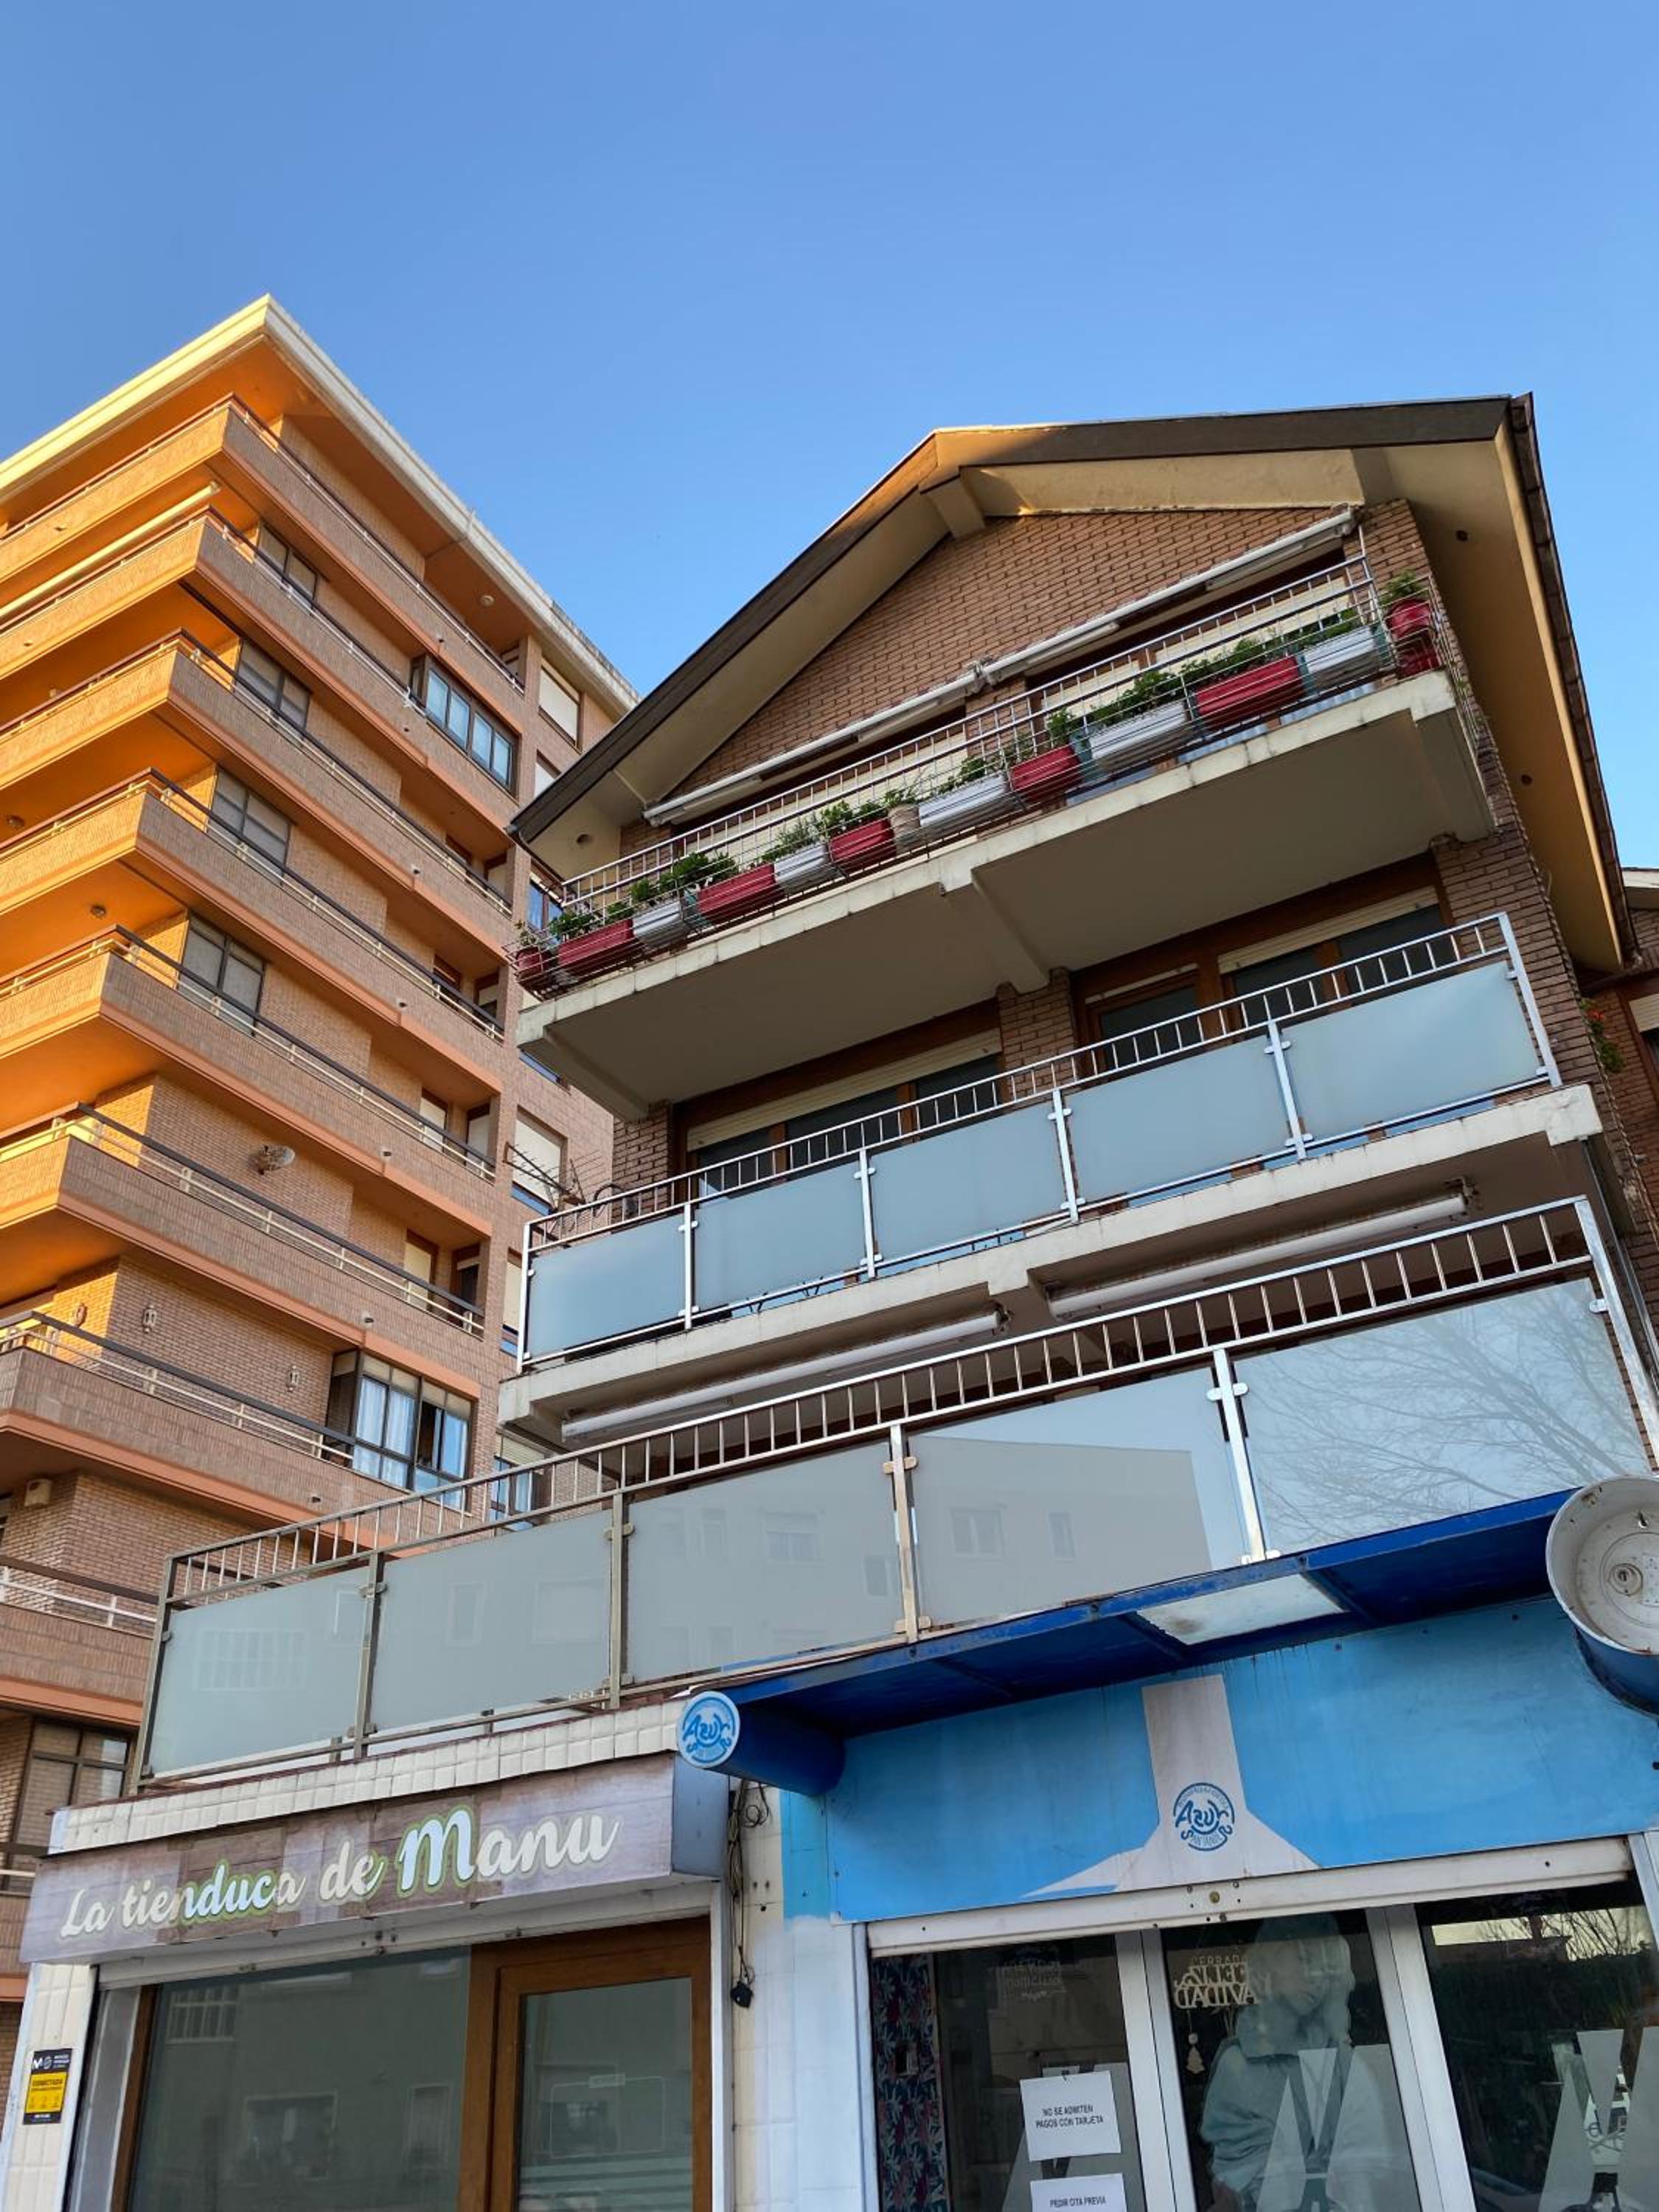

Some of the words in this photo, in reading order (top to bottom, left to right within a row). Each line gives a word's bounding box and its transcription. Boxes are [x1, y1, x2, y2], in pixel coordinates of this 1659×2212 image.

[60, 1888, 115, 1938] La
[122, 1864, 306, 1927] tienduca
[319, 1841, 386, 1900] de
[398, 1809, 619, 1891] Manu
[1043, 2108, 1053, 2117] NO
[1054, 2106, 1062, 2115] SE
[1064, 2104, 1093, 2115] ADMITEN
[1036, 2118, 1058, 2129] PAGOS
[1059, 2118, 1074, 2127] CON
[1075, 2116, 1104, 2125] TARJETA
[1084, 2196, 1106, 2206] PREVIA
